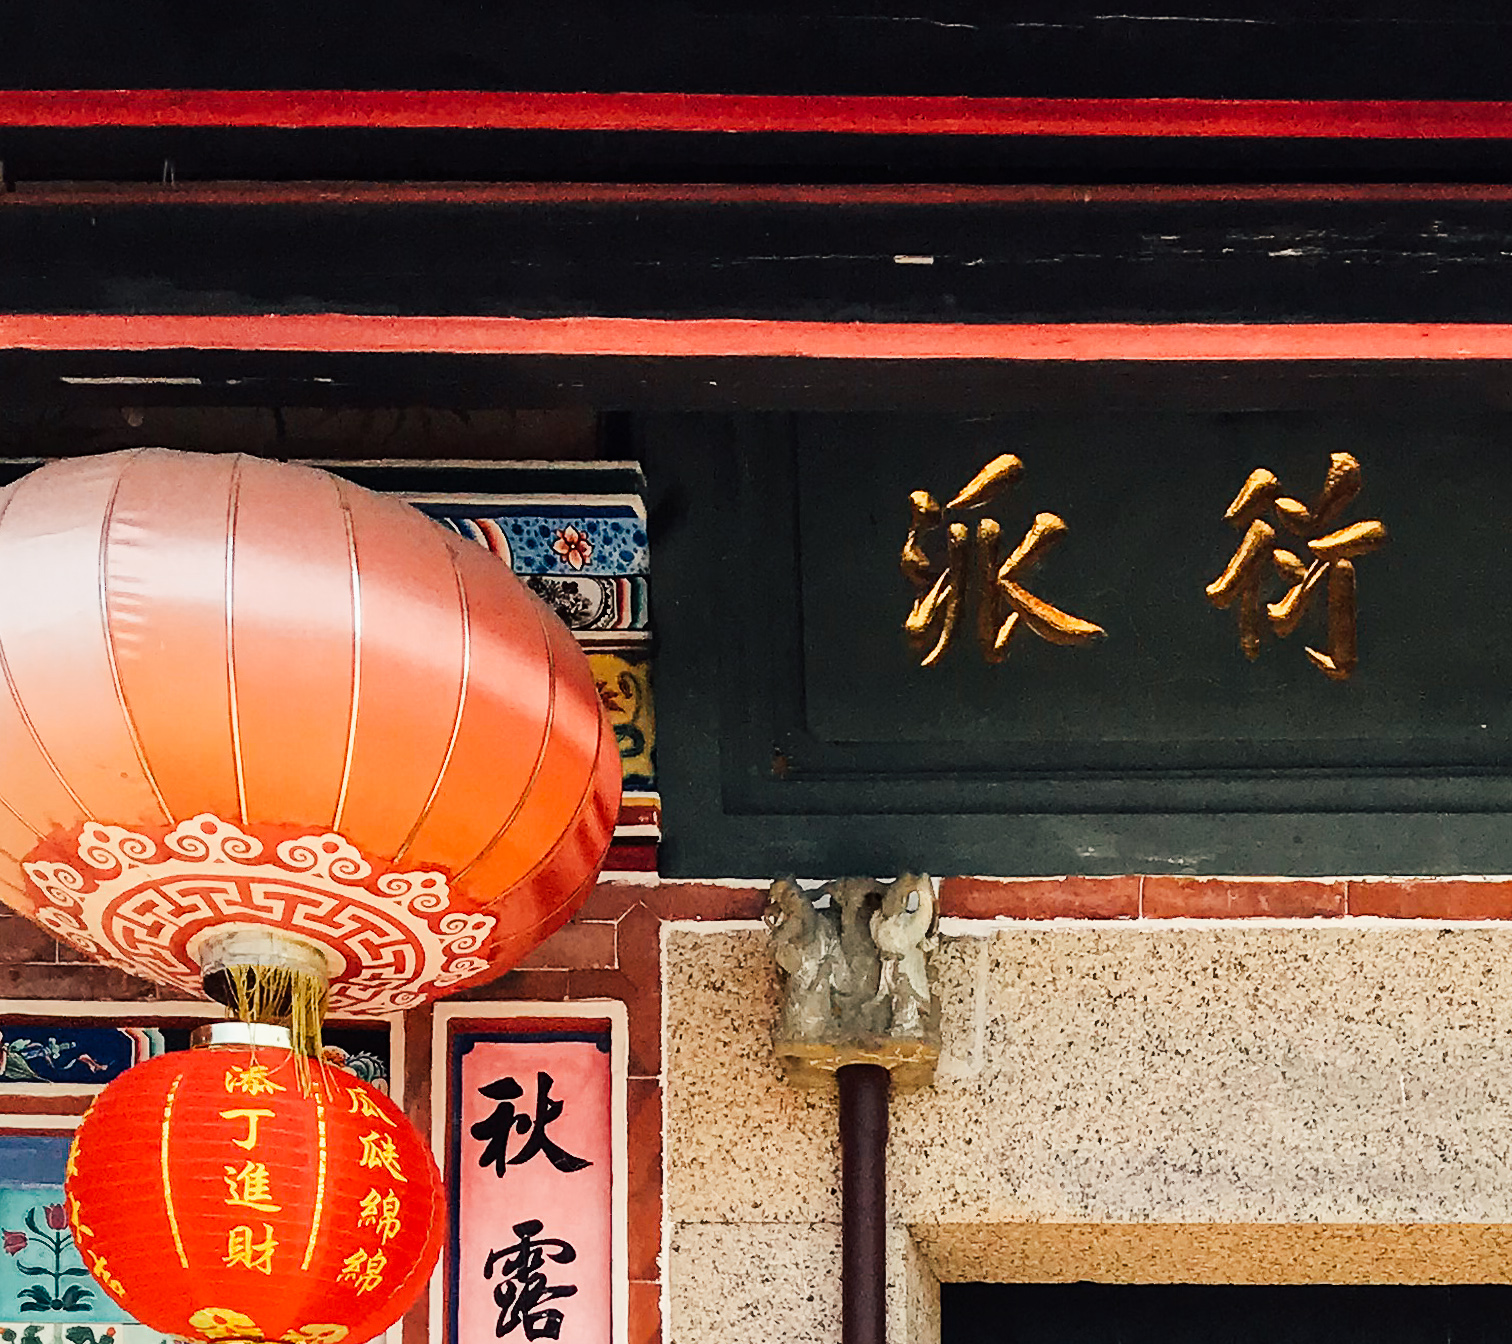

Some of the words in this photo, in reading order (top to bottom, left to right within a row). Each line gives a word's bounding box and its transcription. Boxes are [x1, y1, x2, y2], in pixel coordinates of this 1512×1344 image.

[219, 1065, 286, 1275] 添丁進財
[336, 1086, 408, 1297] 瓜瓞綿綿
